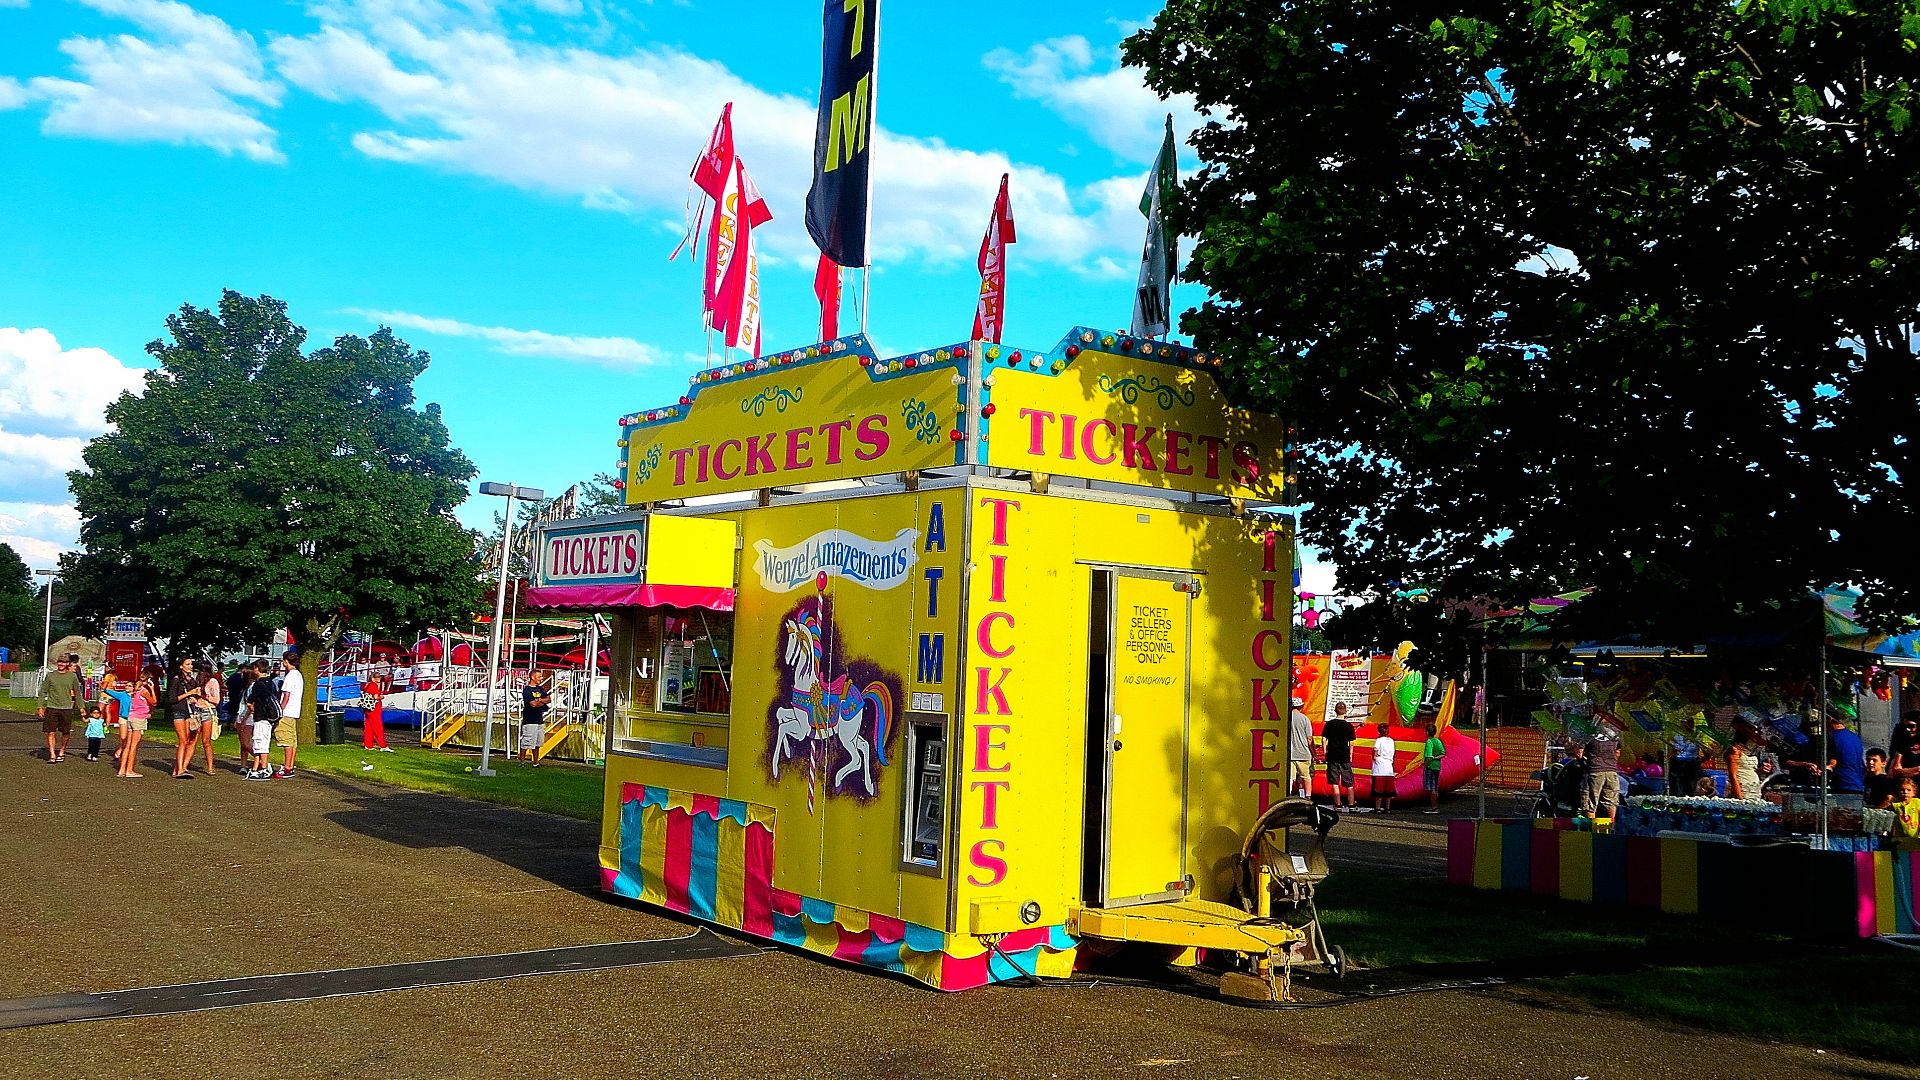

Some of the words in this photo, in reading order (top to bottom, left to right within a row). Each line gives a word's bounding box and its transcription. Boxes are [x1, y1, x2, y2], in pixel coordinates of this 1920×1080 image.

[669, 414, 890, 486] TICKETS
[1020, 408, 1260, 484] TICKETS
[552, 533, 637, 576] TICKETS
[762, 542, 812, 589] Wenzel
[811, 539, 907, 581] Amazements
[917, 502, 946, 684] ATM
[1133, 606, 1168, 618] TICKET
[1131, 617, 1172, 630] SELLERS
[1138, 630, 1168, 641] OFFICE
[1126, 641, 1175, 653] PERSONNEL
[967, 497, 1021, 887] TICKETS
[1123, 676, 1134, 685] NO
[1249, 529, 1285, 845] TICKET
